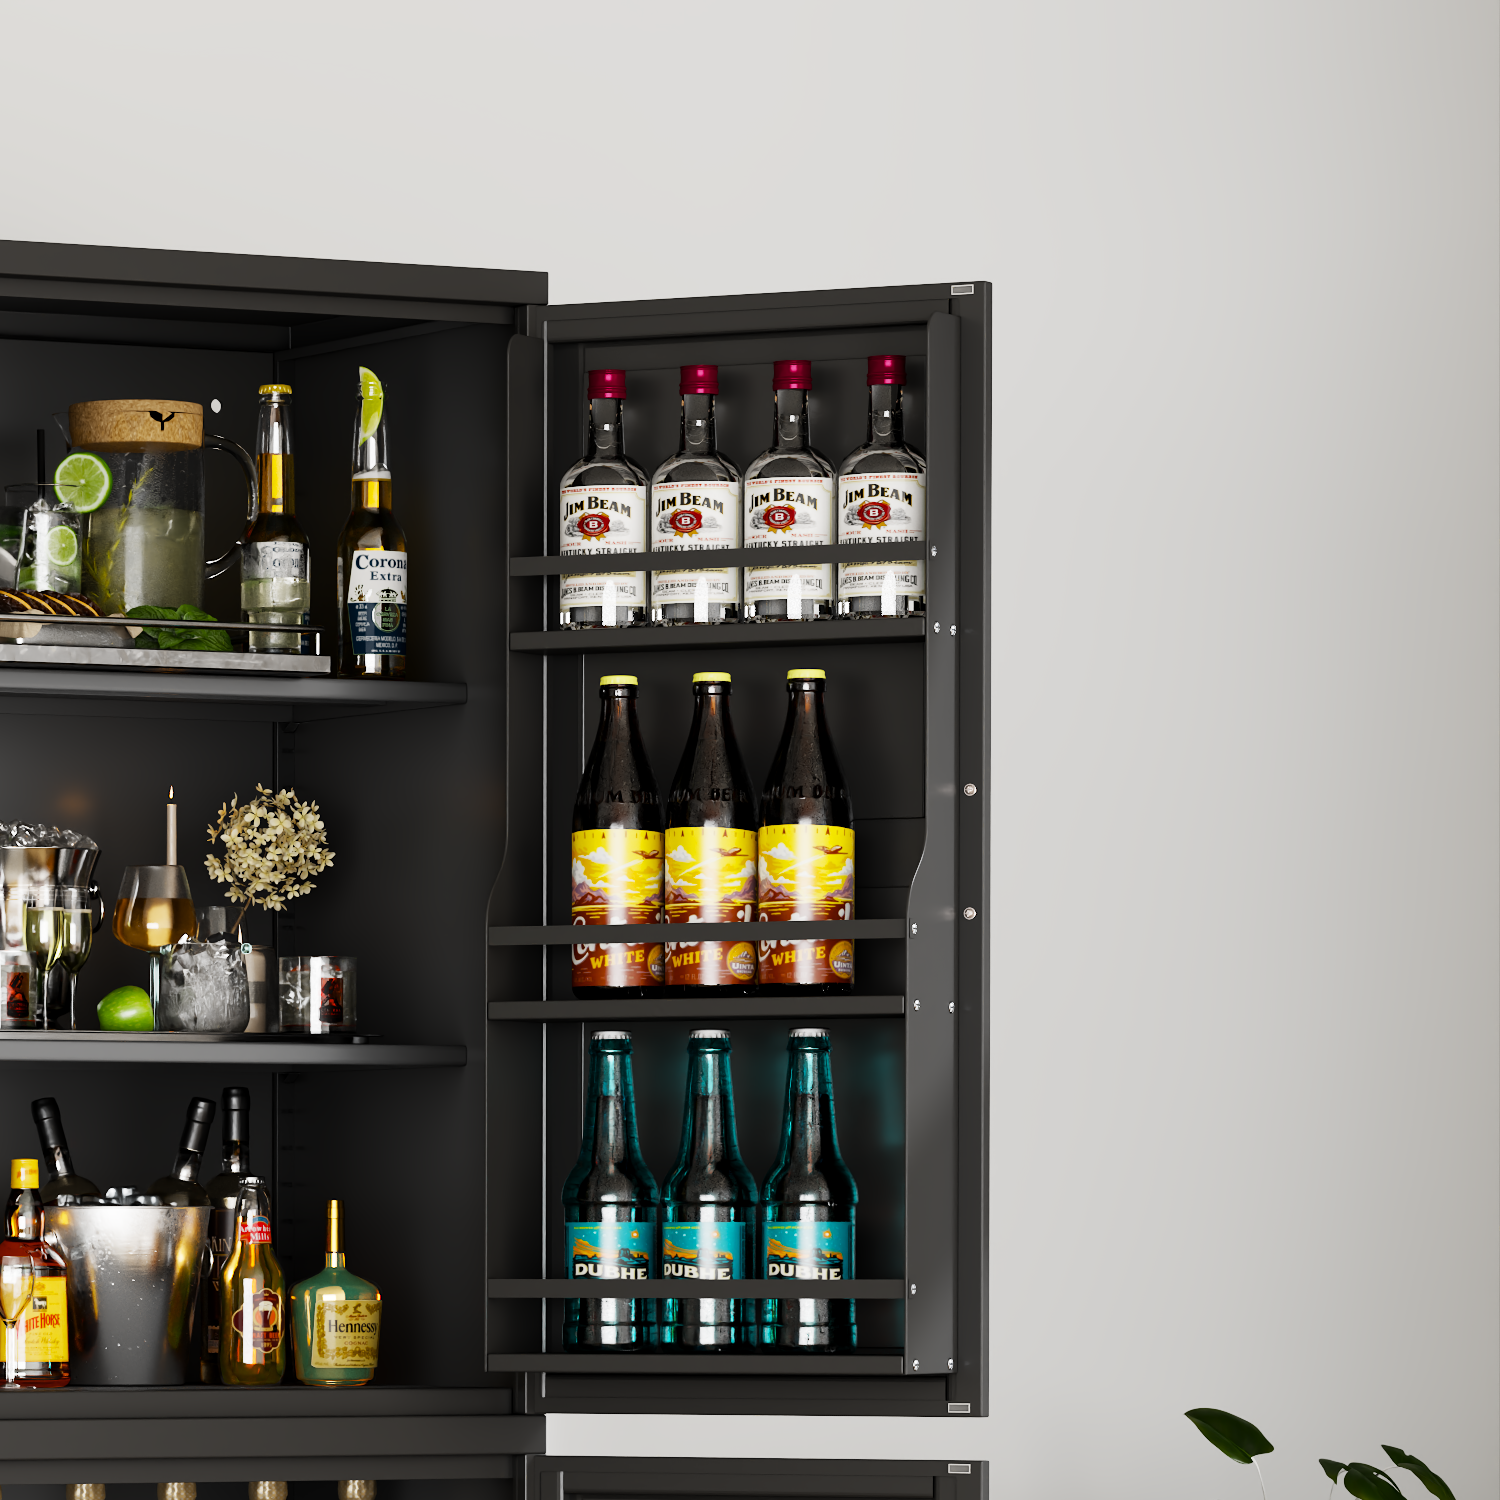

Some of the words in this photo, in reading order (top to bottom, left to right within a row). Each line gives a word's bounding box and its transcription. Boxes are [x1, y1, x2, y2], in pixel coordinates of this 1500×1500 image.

[656, 497, 677, 517] JIM
[680, 492, 724, 515] BEAM
[749, 492, 770, 513] JIM
[773, 488, 818, 511] BEAM
[843, 488, 865, 509] JIM
[868, 483, 913, 507] BEAM
[564, 500, 584, 521] JIM
[588, 496, 631, 518] BEAM
[869, 509, 879, 517] B
[682, 517, 691, 525] B
[370, 571, 403, 582] Extra
[590, 949, 645, 969] WHITE
[671, 947, 724, 968] WHITE
[771, 946, 826, 967] WHITE
[251, 1232, 270, 1241] Mills
[575, 1263, 648, 1280] DUBHE
[663, 1263, 731, 1280] DUBHE
[768, 1263, 842, 1281] DUBHE
[40, 1312, 61, 1328] HORSE
[328, 1319, 379, 1336] Hennessy
